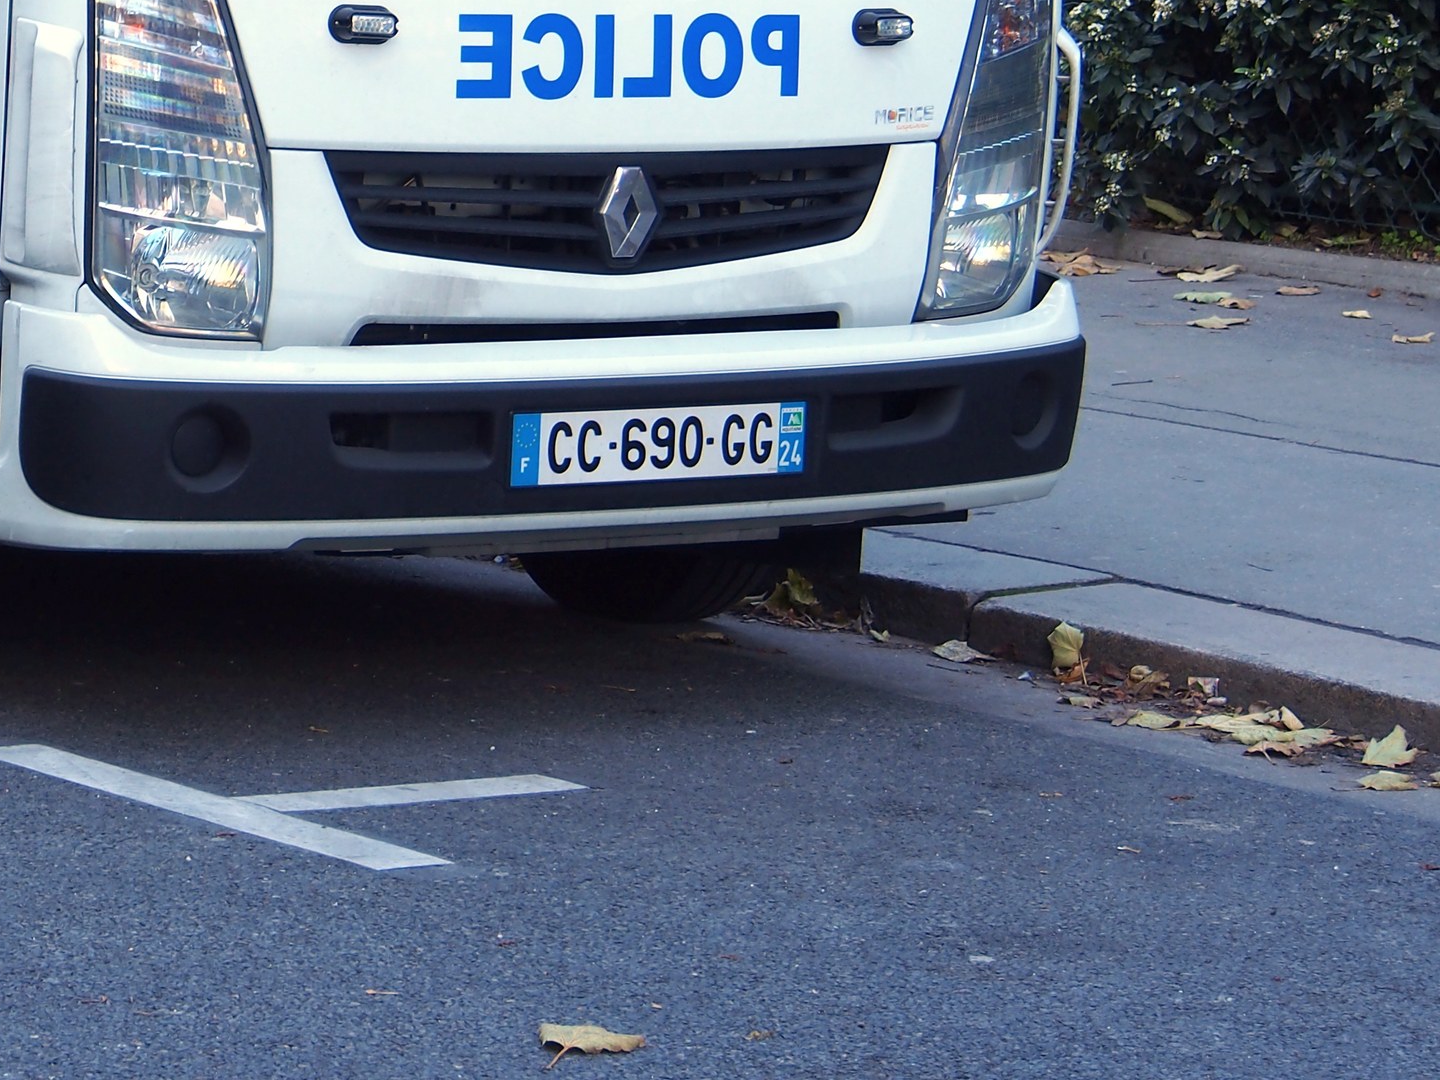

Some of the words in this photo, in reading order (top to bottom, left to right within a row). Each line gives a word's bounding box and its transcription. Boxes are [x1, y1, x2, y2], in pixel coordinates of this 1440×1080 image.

[874, 104, 935, 125] MORICE
[519, 457, 530, 474] F
[778, 439, 802, 467] 24
